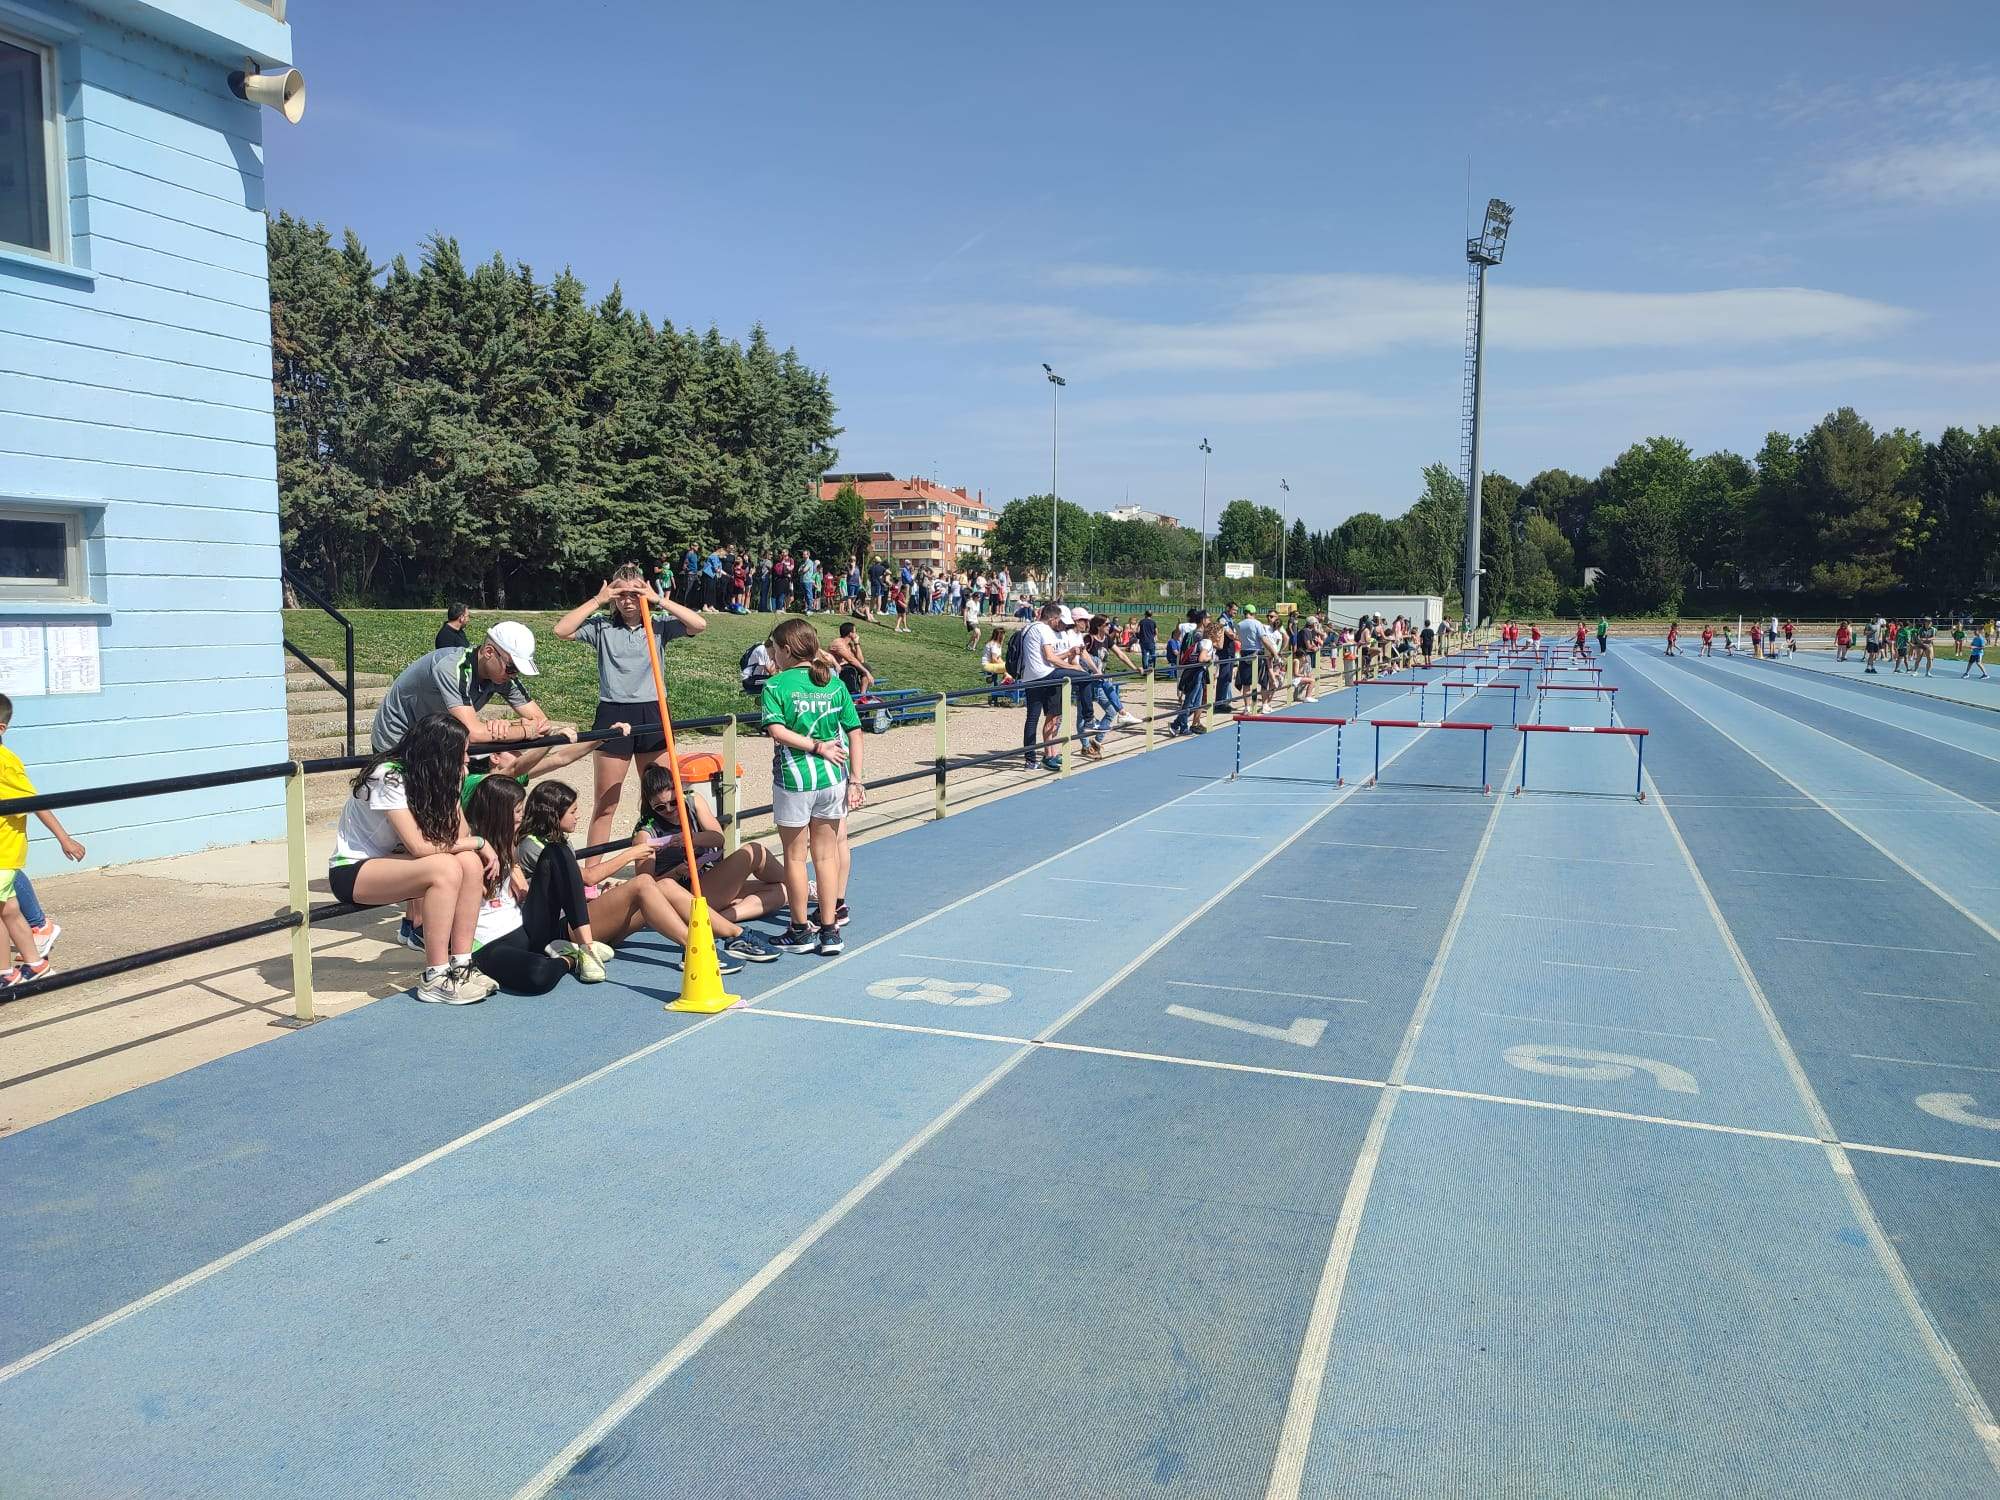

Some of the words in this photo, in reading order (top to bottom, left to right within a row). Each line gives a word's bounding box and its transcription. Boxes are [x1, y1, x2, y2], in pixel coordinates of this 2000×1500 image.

[865, 976, 1013, 1007] 8
[1165, 1003, 1329, 1048] 7
[1502, 1044, 1699, 1095] 6
